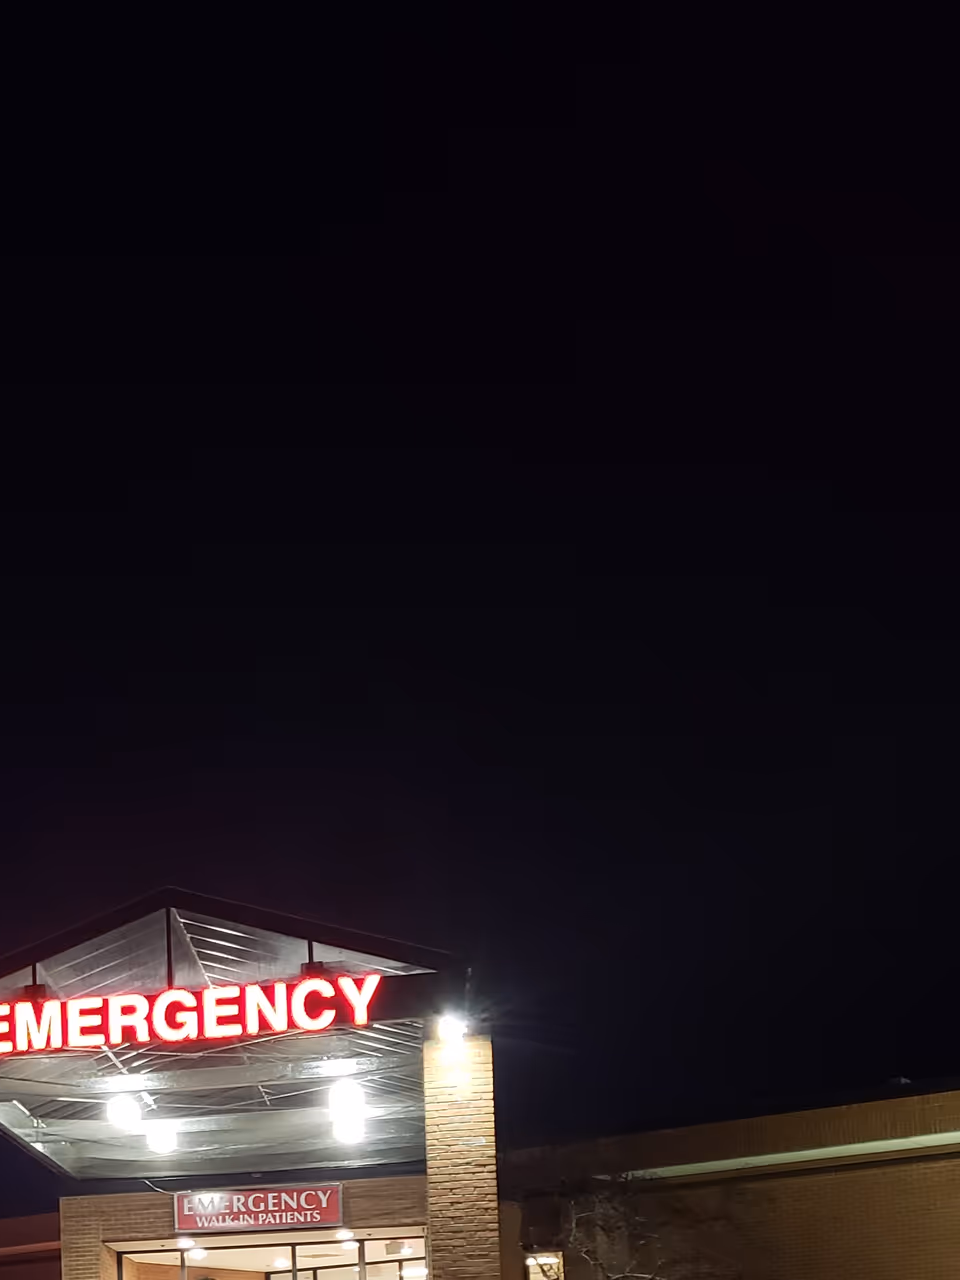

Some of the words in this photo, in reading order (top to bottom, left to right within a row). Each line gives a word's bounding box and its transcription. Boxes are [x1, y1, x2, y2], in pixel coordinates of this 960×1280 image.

[183, 1190, 331, 1214] EMERGENCY
[196, 1214, 254, 1228] WALK-IN
[258, 1210, 321, 1225] PATIENTS
